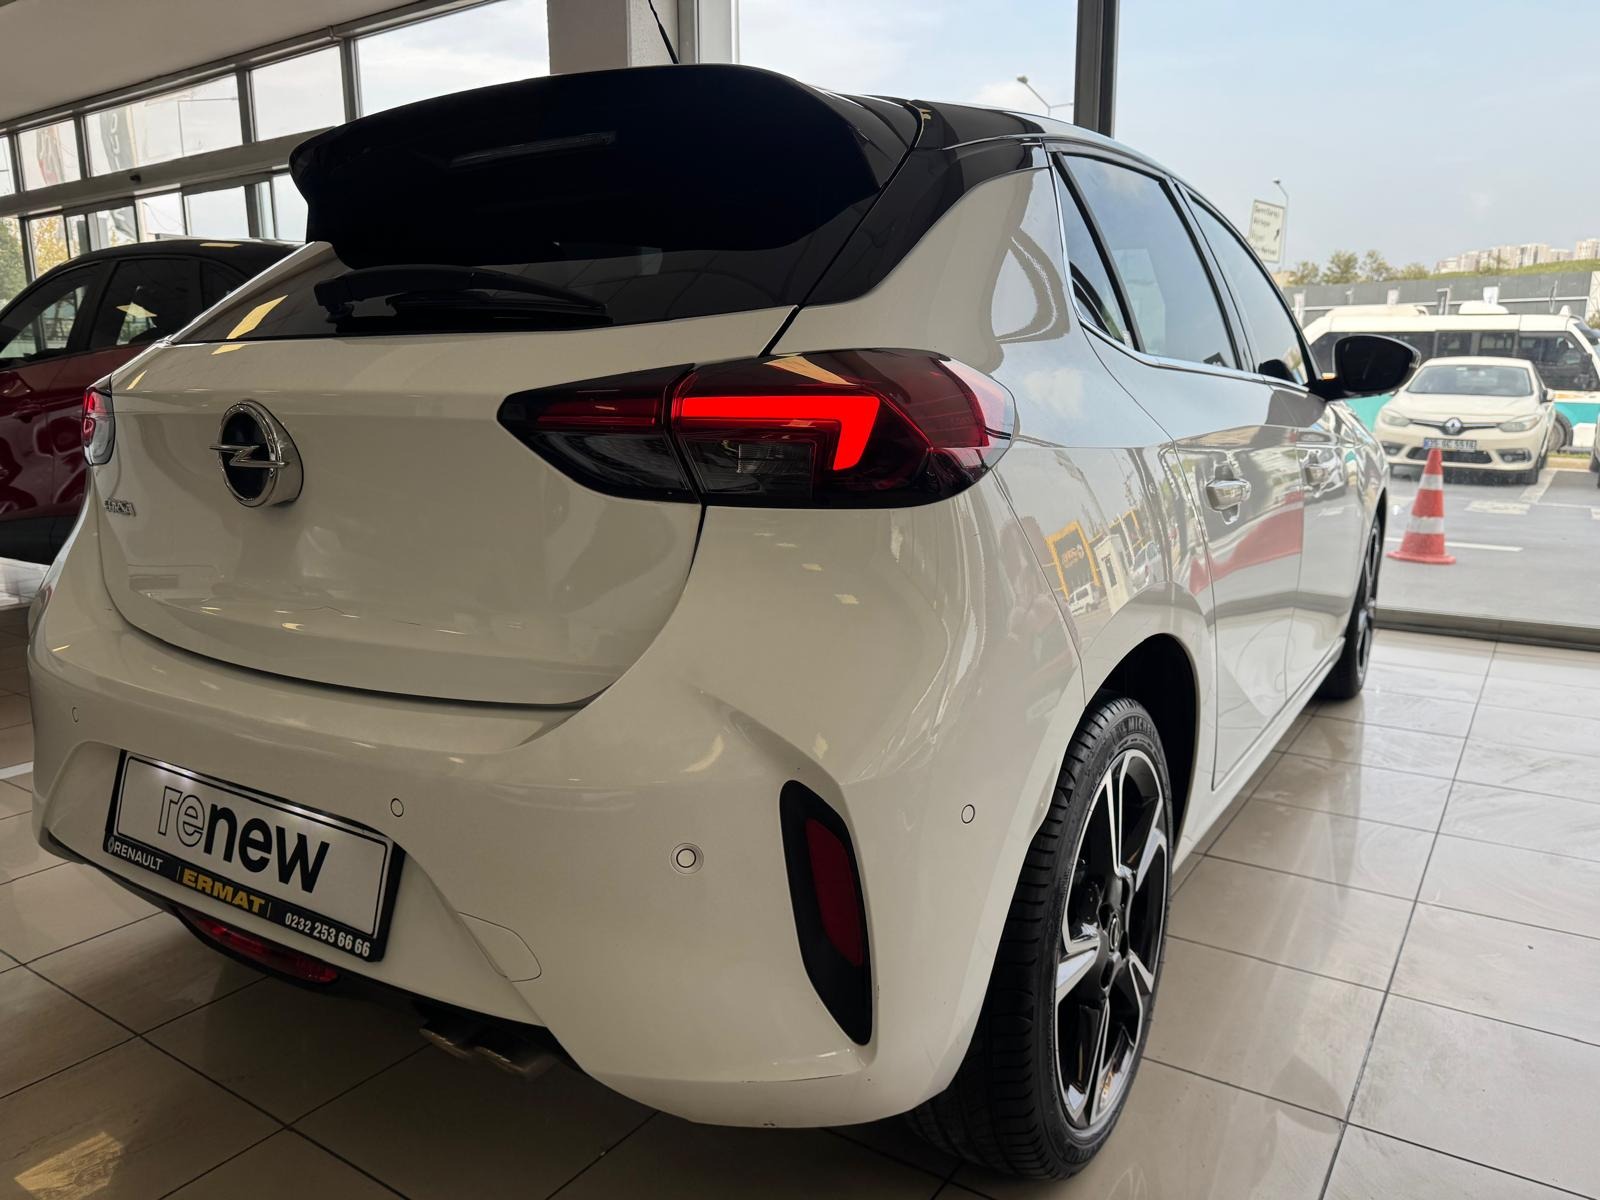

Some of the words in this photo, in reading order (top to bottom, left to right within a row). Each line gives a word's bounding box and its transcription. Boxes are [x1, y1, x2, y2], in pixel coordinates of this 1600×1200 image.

[158, 785, 331, 894] renew
[114, 841, 164, 871] RENAULT
[182, 867, 266, 914] ERMAT
[284, 912, 312, 934] 0232
[313, 922, 336, 943] 253
[337, 931, 354, 950] 66
[354, 938, 371, 958] 66
